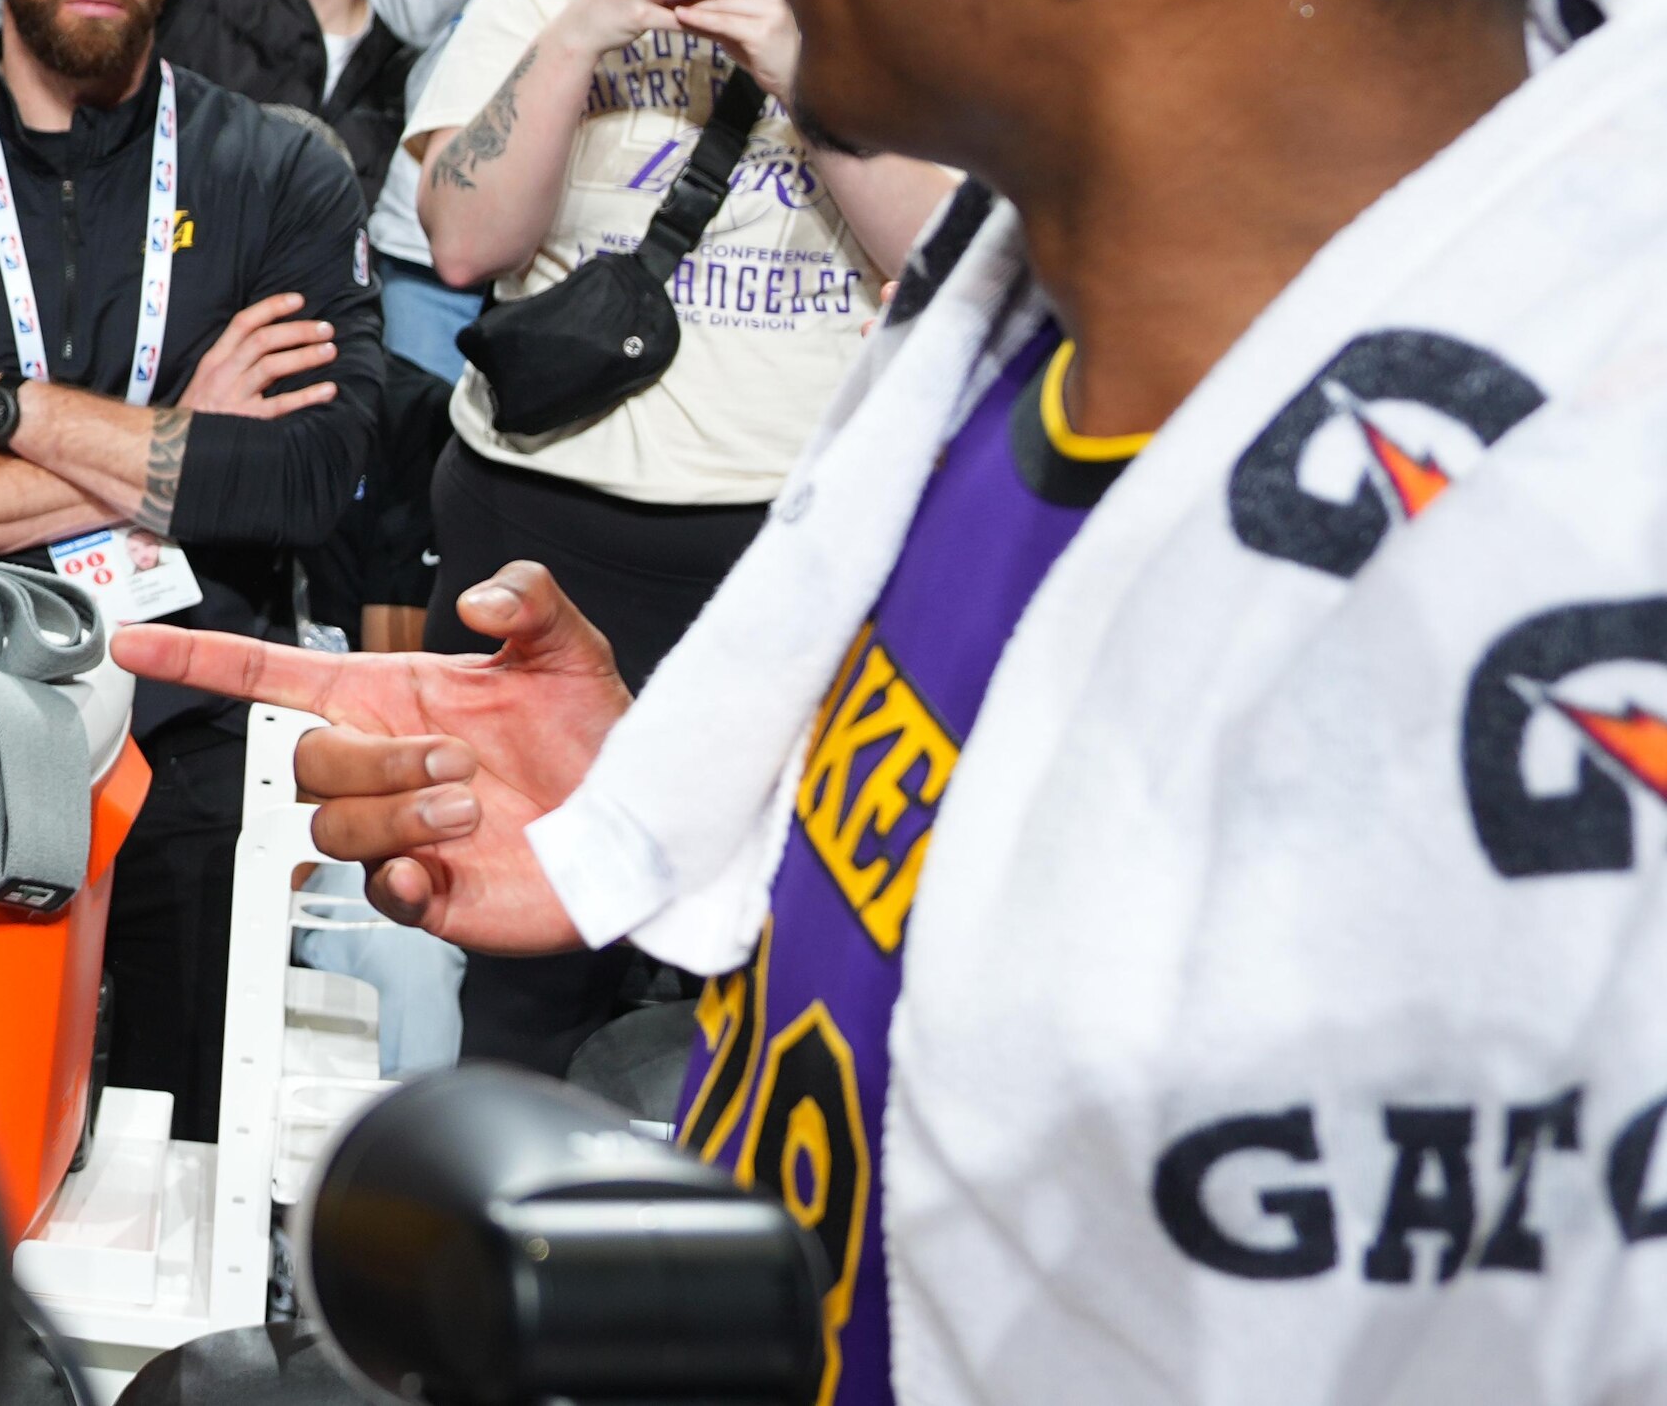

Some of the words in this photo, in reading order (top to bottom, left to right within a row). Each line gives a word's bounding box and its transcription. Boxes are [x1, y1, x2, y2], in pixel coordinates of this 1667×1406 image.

[585, 66, 690, 113] AKERS
[700, 244, 835, 264] CONFERENCE
[674, 258, 863, 314] ANGELES
[709, 311, 797, 331] DIVISION
